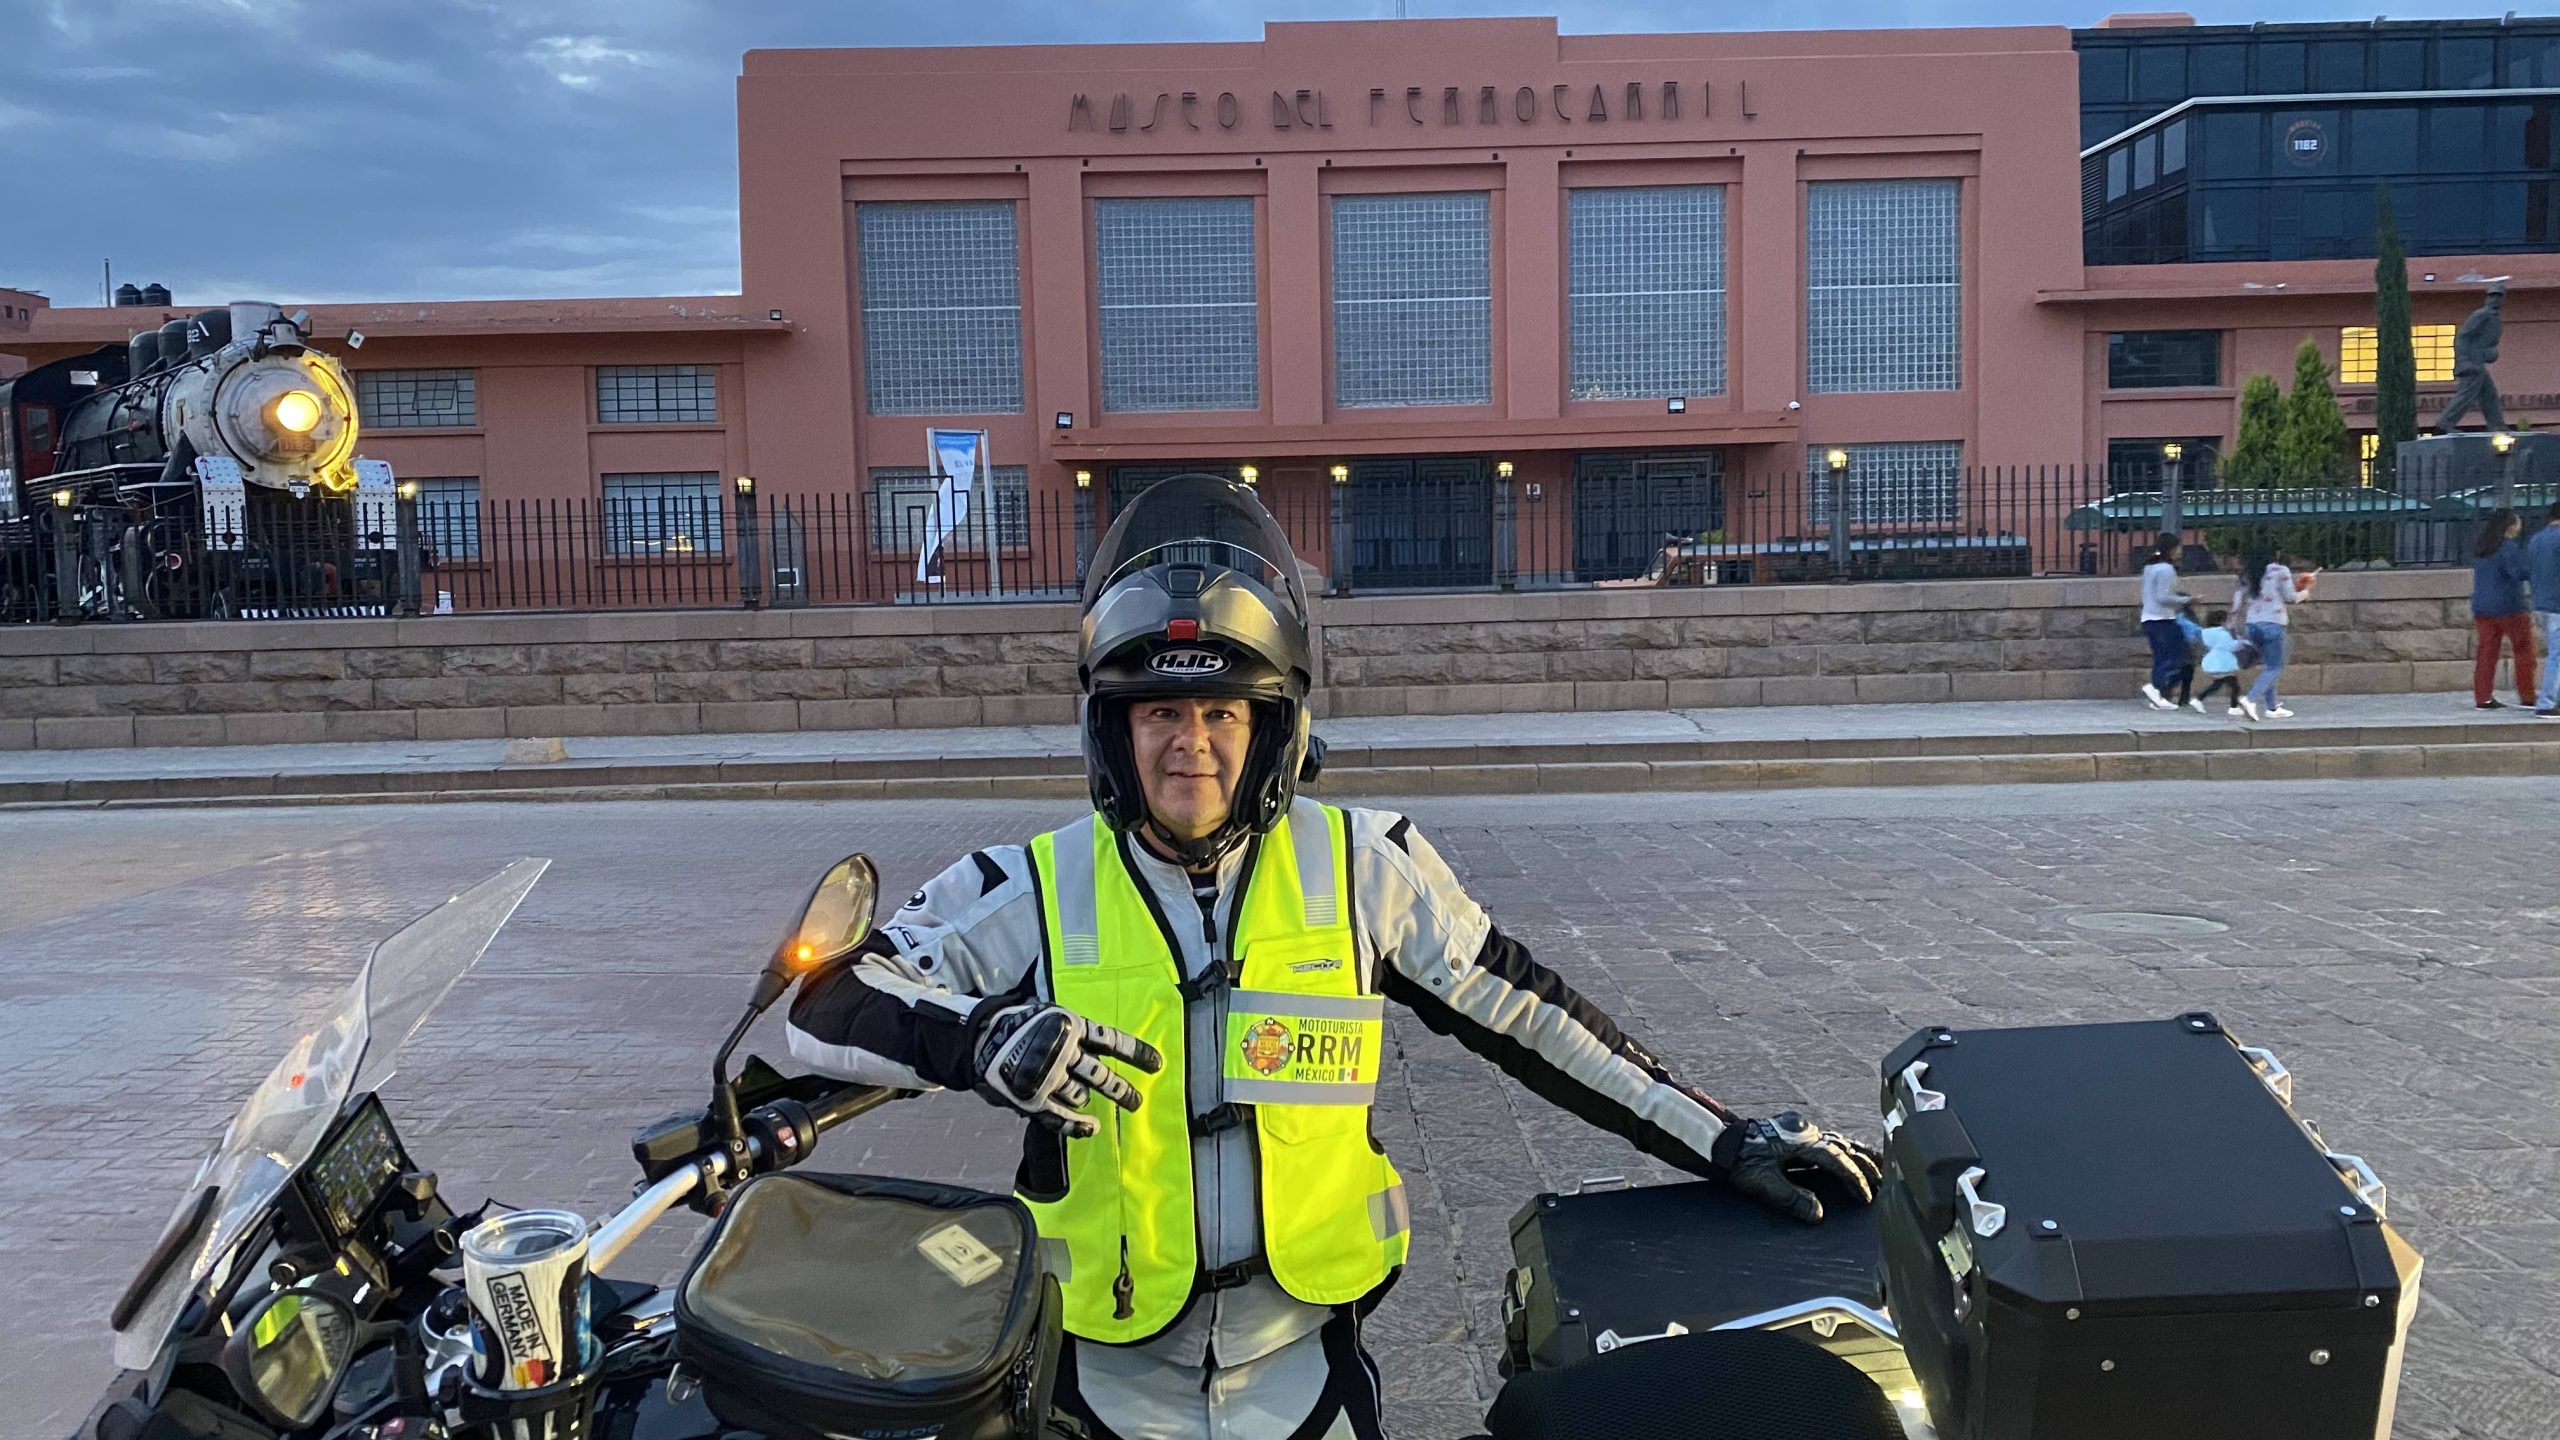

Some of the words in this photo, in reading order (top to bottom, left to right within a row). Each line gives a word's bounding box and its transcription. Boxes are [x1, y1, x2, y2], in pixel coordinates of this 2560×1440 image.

[1068, 91, 1236, 132] MUSEO
[1272, 89, 1334, 128] DEL
[1369, 80, 1758, 127] FERROCARRIL
[2294, 139, 2318, 150] 1182
[1155, 654, 1219, 669] HJC
[1298, 1018, 1363, 1034] MOTOTURISTA
[1296, 1033, 1362, 1066] RRM
[1295, 1066, 1335, 1081] MÉXICO
[493, 1282, 530, 1358] GERMANY
[508, 1284, 535, 1331] MADE
[525, 1332, 543, 1350] IN
